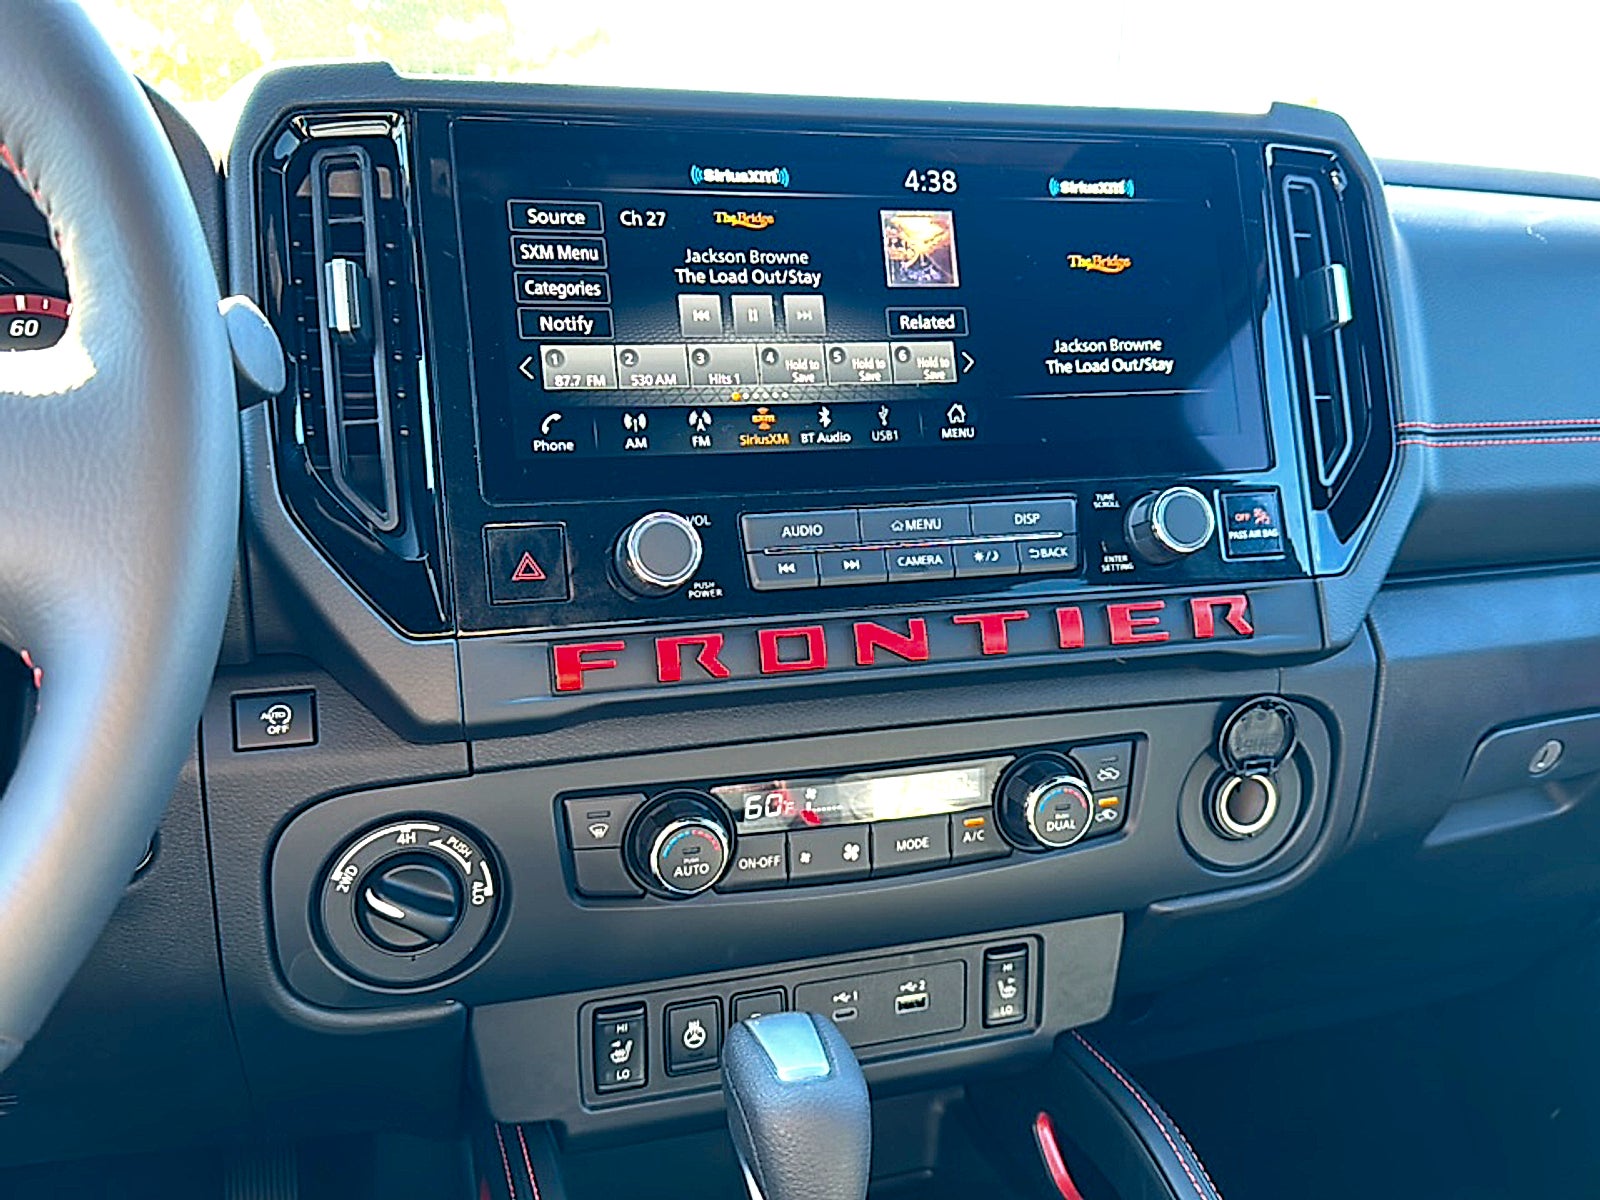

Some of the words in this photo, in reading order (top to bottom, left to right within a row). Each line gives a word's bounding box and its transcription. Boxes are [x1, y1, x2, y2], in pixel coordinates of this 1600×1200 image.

[904, 169, 958, 193] 4:38
[527, 208, 586, 226] Source
[619, 209, 643, 227] Ch
[646, 211, 667, 227] 27
[713, 212, 736, 225] The
[733, 212, 775, 229] Bridge
[520, 244, 555, 261] SXM
[557, 245, 599, 261] Menu
[685, 248, 746, 265] Jackson
[749, 250, 809, 265] Browne
[1067, 254, 1091, 269] The
[1090, 254, 1132, 274] Bridge
[674, 268, 706, 284] The
[709, 269, 748, 285] Load
[751, 270, 822, 288] Out/Stay
[524, 280, 602, 299] Categories
[9, 319, 39, 337] 60
[539, 315, 594, 334] Notify
[899, 314, 956, 331] Related
[1054, 338, 1107, 354] Jackson
[1109, 338, 1162, 352] Browne
[551, 353, 558, 365] 1
[624, 353, 634, 365] 2
[696, 352, 705, 364] 3
[765, 352, 774, 363] 4
[832, 351, 842, 363] 5
[898, 350, 907, 362] 6
[916, 356, 938, 368] Hold
[940, 357, 950, 368] to
[785, 359, 807, 371] Hold
[809, 360, 820, 371] to
[852, 358, 875, 370] Hold
[876, 359, 886, 370] to
[1045, 359, 1073, 375] The
[1075, 359, 1109, 374] Load
[1112, 358, 1174, 374] Out/Stay
[554, 375, 580, 387] 87.7
[586, 375, 606, 386] FM
[631, 374, 653, 387] 530
[655, 374, 677, 386] AM
[708, 373, 732, 385] Hits
[735, 373, 741, 385] 1
[792, 372, 815, 384] Save
[858, 371, 881, 382] Save
[923, 369, 946, 381] Save
[739, 433, 789, 446] SiriusXM
[801, 433, 815, 444] BT
[817, 432, 852, 444] Audio
[871, 430, 899, 442] USB1
[941, 427, 975, 440] MENU
[533, 439, 575, 452] Phone
[625, 437, 647, 449] AM
[692, 436, 711, 448] FM
[686, 514, 711, 528] VOL
[905, 518, 942, 531] MENU
[1014, 512, 1041, 526] DISP
[782, 524, 823, 538] AUDIO
[1228, 530, 1247, 540] PASS
[1248, 530, 1261, 539] AIR
[1262, 528, 1279, 538] BAG
[1041, 546, 1068, 559] BACK
[1104, 554, 1129, 564] ENTER
[897, 554, 943, 567] CAMERA
[1101, 562, 1135, 573] SETTING
[693, 581, 715, 590] PUSH
[688, 589, 723, 599] POWER
[552, 594, 1255, 693] FRONTIER
[266, 724, 290, 735] OFF
[1046, 819, 1076, 832] DUAL
[397, 831, 417, 846] 4H
[962, 829, 985, 844] A/C
[446, 836, 473, 858] PUSH
[896, 837, 930, 852] MODE
[738, 855, 781, 870] ON-OFF
[673, 863, 710, 878] AUTO
[336, 865, 359, 894] 2WD
[919, 980, 926, 991] 2
[1000, 1005, 1013, 1015] LO
[616, 1023, 628, 1034] HI
[616, 1068, 631, 1080] LO
